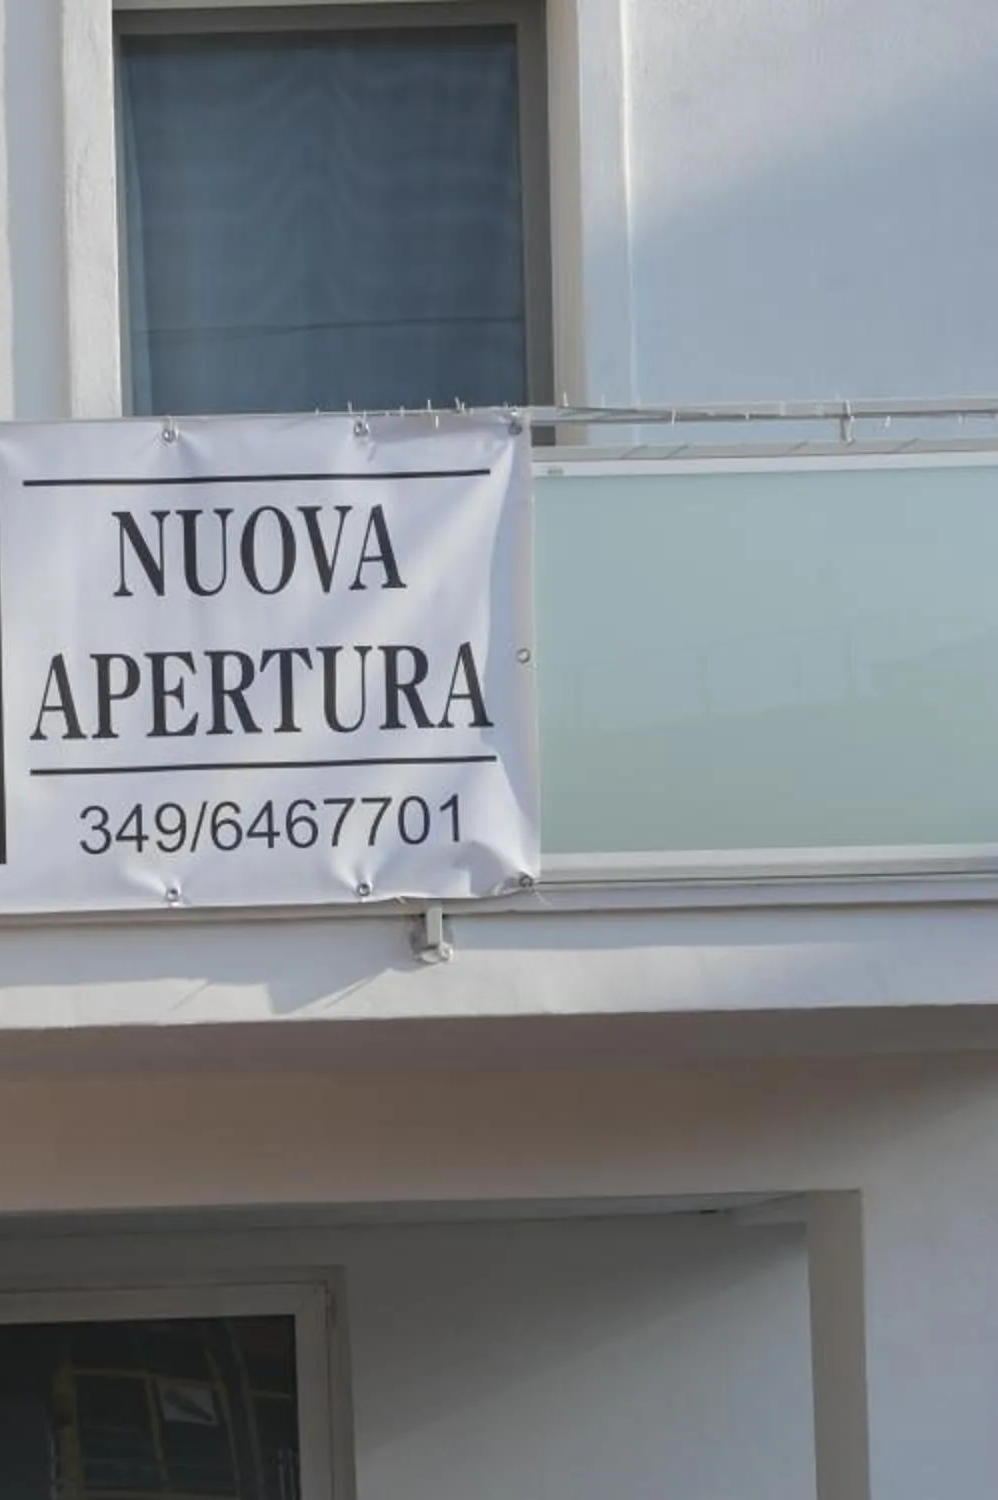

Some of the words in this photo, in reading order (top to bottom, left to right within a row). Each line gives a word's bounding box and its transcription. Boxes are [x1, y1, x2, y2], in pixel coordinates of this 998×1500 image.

[112, 504, 407, 598] NUOVA
[29, 641, 494, 741] APERTURA
[79, 794, 462, 854] 349/6467701
